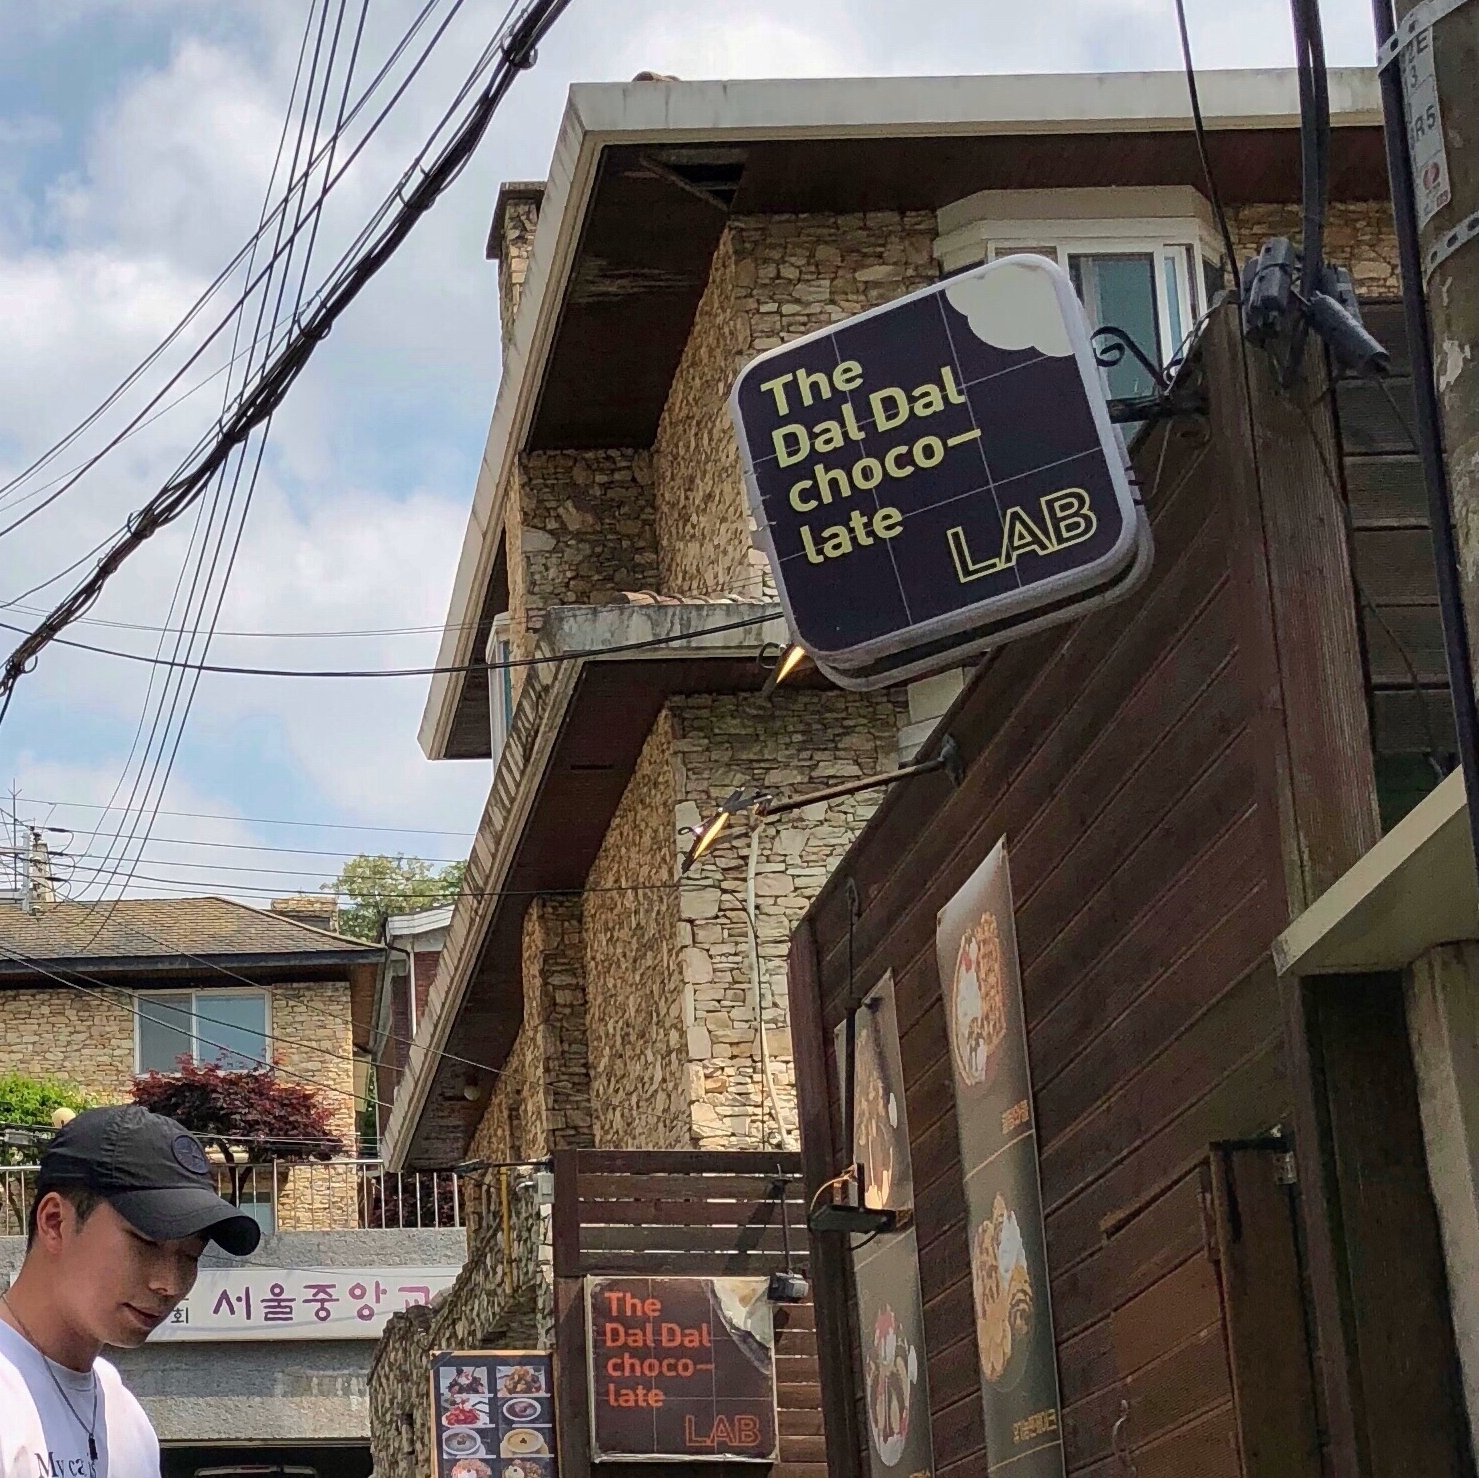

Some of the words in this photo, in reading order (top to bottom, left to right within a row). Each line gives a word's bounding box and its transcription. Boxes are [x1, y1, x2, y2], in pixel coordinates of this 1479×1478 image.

[760, 360, 865, 417] The
[772, 404, 866, 468] Dal
[869, 366, 966, 432] Dal
[800, 506, 904, 565] late
[947, 487, 1098, 584] LAB
[604, 1291, 662, 1317] The
[605, 1322, 655, 1348] Dal
[661, 1322, 712, 1348] Dal
[608, 1383, 666, 1407] late
[685, 1414, 761, 1447] LAB
[69, 1458, 88, 1477] ca
